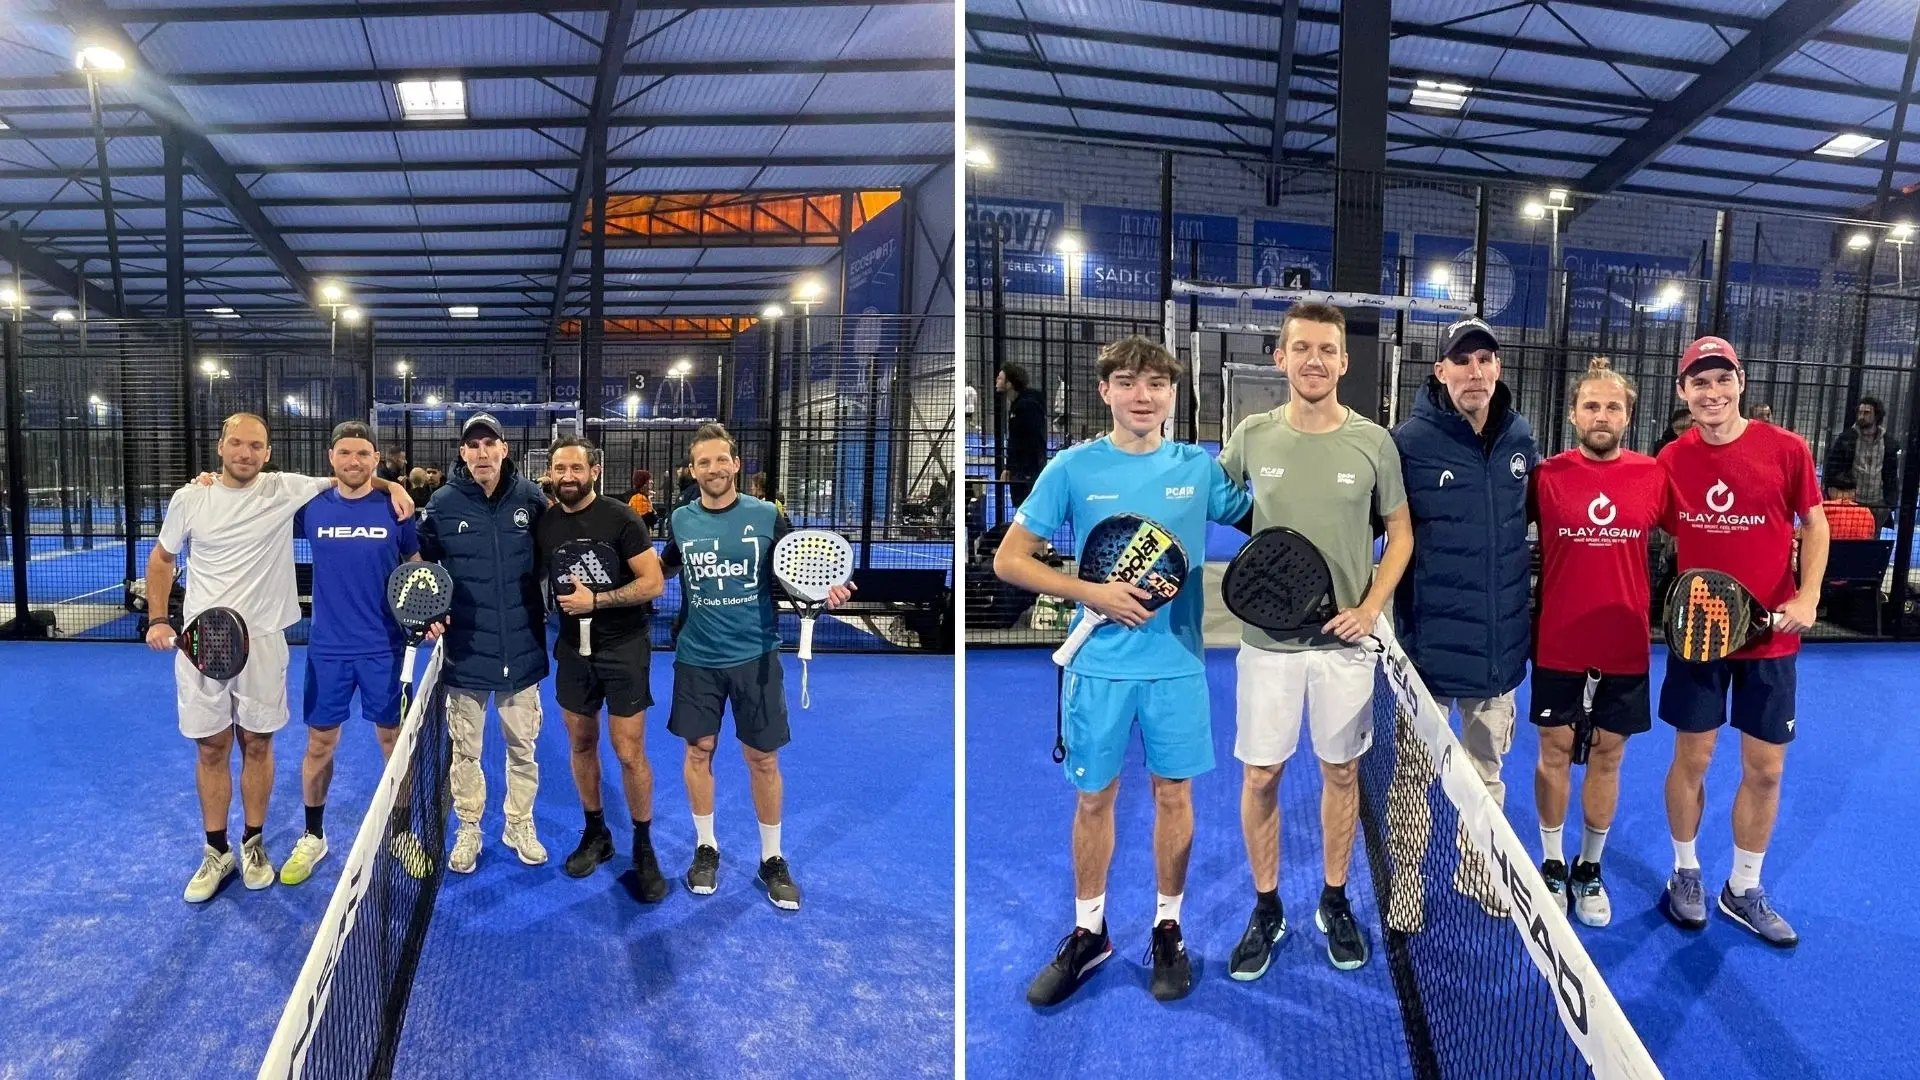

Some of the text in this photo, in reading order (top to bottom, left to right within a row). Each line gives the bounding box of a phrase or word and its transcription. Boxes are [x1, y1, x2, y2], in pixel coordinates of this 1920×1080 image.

[1094, 267, 1156, 287] SADEC
[1289, 274, 1302, 290] 4
[1357, 298, 1386, 306] HEAD
[1438, 303, 1468, 312] HEAD
[635, 374, 645, 389] 3
[459, 390, 533, 403] KIMBO
[1678, 511, 1766, 525] PLAY AGAIN
[317, 526, 388, 539] HEAD
[1558, 527, 1642, 538] PLAY AGAIN
[688, 551, 717, 565] we
[693, 559, 748, 581] padel
[703, 597, 721, 606] Club
[1490, 829, 1589, 1036] HEAD
